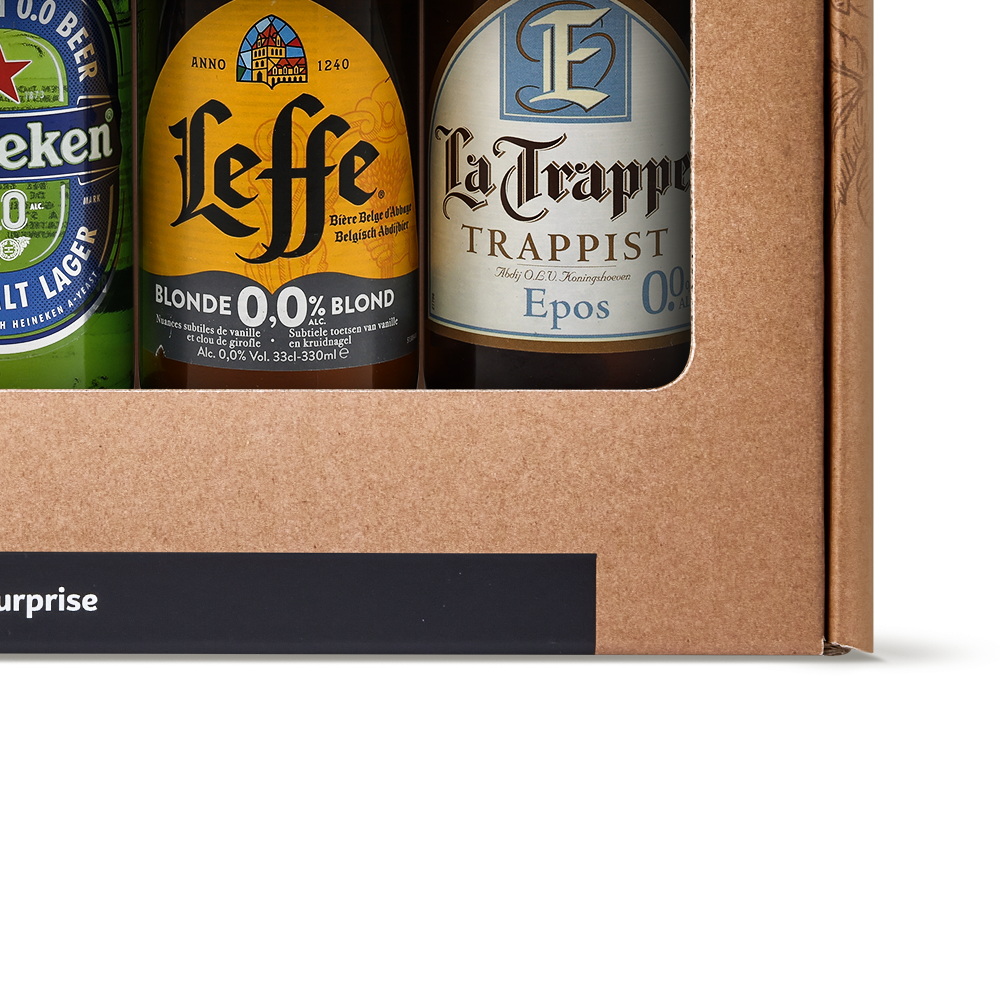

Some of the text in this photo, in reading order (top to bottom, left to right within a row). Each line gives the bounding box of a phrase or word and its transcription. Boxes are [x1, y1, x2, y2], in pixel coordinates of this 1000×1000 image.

[56, 10, 99, 82] BEER
[191, 56, 350, 72] ANNO 1240
[24, 89, 46, 101] 1873
[168, 92, 380, 264] Leffe
[434, 123, 498, 220] La
[30, 202, 45, 211] ALC.
[83, 194, 101, 205] MARK
[329, 203, 412, 226] Bière Belge d'Abbaye
[334, 220, 410, 244] Belgisch Abdijbier
[460, 224, 669, 262] TRAPPIST
[38, 226, 98, 299] LAGER
[494, 266, 522, 283] Abdij
[558, 270, 632, 285] Koningshoeven
[12, 306, 64, 329] HEINEKEN
[67, 271, 98, 308] A-YEAST
[155, 283, 232, 316] BLONDE
[331, 288, 395, 316] BLOND
[523, 287, 610, 330] Epos
[679, 296, 691, 310] AL
[156, 313, 261, 338] Nuances subtiles de vanille
[288, 316, 399, 338] Subtiele toetsen van vanille
[308, 318, 327, 326] ALC.
[186, 334, 261, 349] et clou de girofle
[303, 335, 352, 348] kruidnagel
[197, 346, 216, 359] Alc.
[218, 348, 247, 362] 0,0%
[249, 350, 270, 362] Vol.
[273, 348, 337, 362] 33cl-330ml
